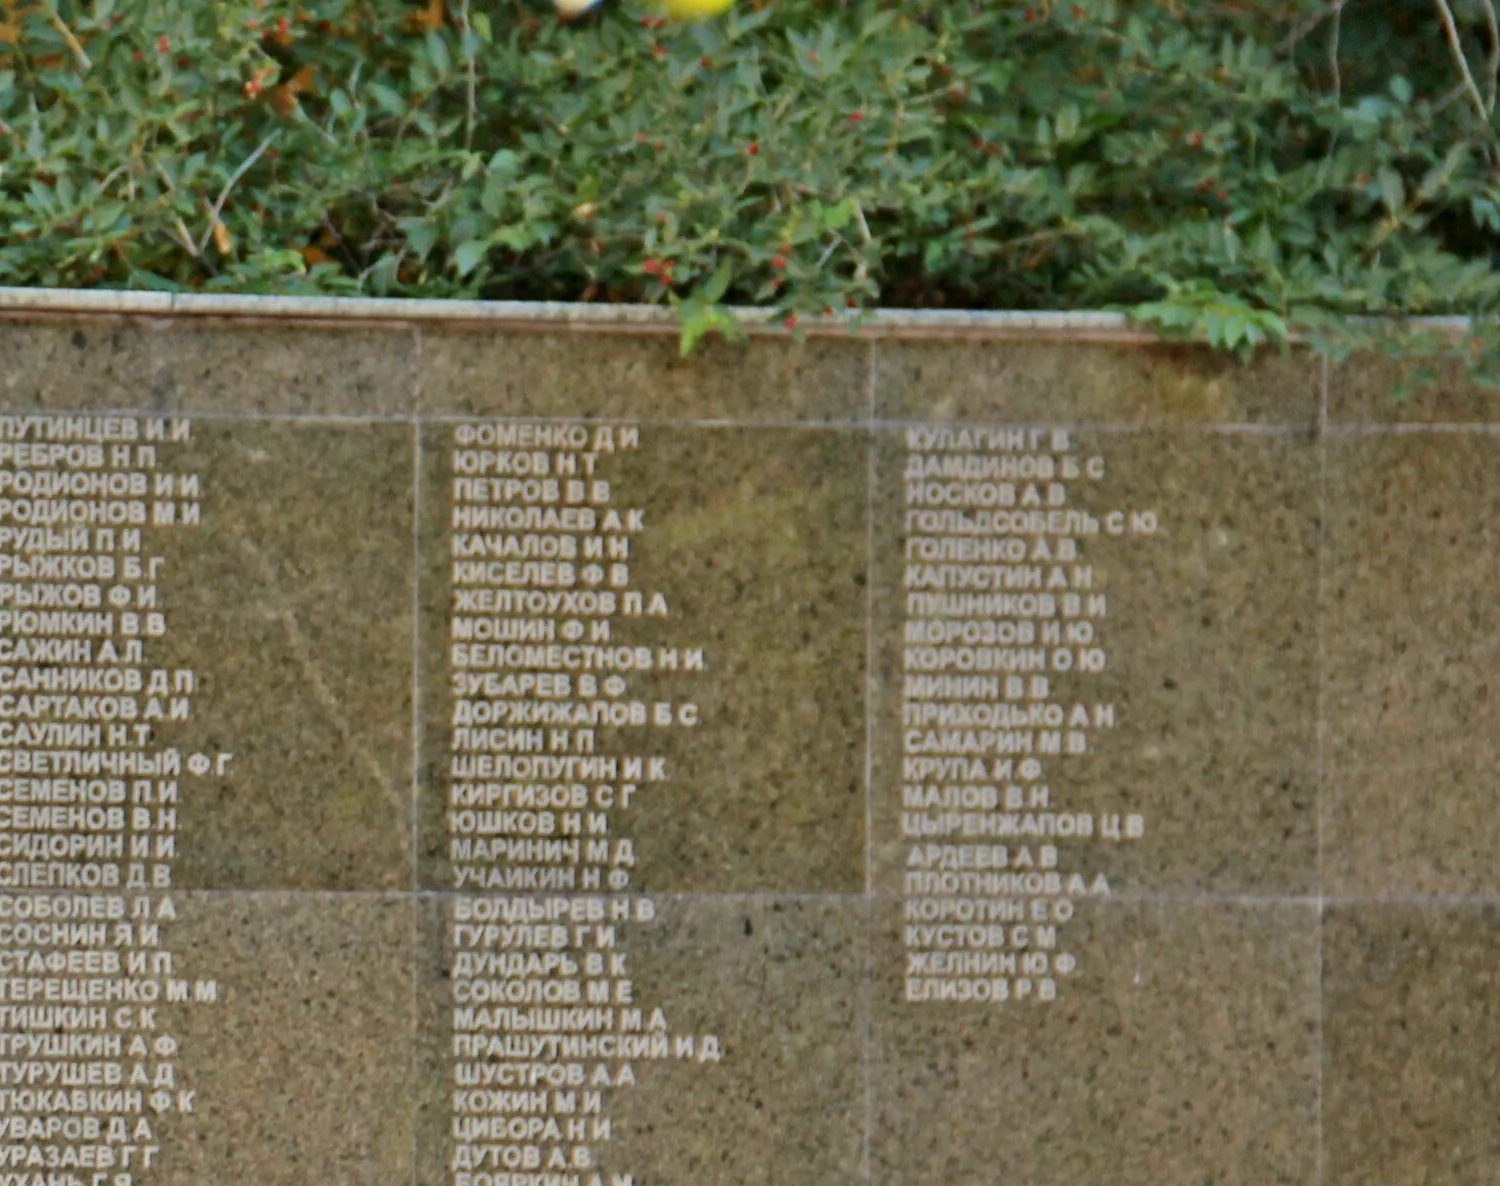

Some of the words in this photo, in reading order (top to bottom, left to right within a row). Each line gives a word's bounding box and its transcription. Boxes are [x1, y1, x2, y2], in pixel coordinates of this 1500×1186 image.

[454, 423, 587, 447] ФОМЕНКО
[453, 450, 548, 474] ЮРКОВ
[453, 478, 558, 501] ПЕТРОВ
[908, 483, 1015, 505] НОСКОВ
[452, 506, 595, 530] НИКОЛАЕВ
[453, 535, 576, 558] КАЧАЛОВ
[905, 565, 1042, 588] КАПУСТИН
[453, 590, 615, 614] ЖЕЛТОУХОВ
[452, 618, 554, 640] МОШИН
[452, 644, 651, 669] БЕЛОМЕСТНОВ
[903, 648, 1045, 670] КОРОВКИН
[452, 673, 571, 696] ЗУБАРЕВ
[904, 676, 998, 698] МИНИН
[903, 703, 1063, 728] ПРИХОДЬКО
[452, 729, 542, 750] ЛИСИН
[904, 731, 1032, 753] САМАРИН
[452, 756, 616, 778] ШЕЛОПУГИН
[903, 758, 985, 780] КРУПА
[452, 784, 587, 807] КИРГИЗОВ
[451, 812, 554, 833] ЮШКОВ
[908, 845, 1008, 869] АРДЕЕВ
[454, 897, 603, 922] БОЛДЫРЕВ
[905, 899, 1023, 921] КОРОТИН
[454, 925, 568, 947] ГУРУЛЕВ
[905, 926, 1004, 948] КУСТОВ
[452, 952, 577, 979] ДУНДАРЬ
[906, 952, 1015, 974] ЖЕЛНИН
[453, 981, 580, 1003] СОКОЛОВ
[453, 1008, 613, 1030] МАЛЫШКИН
[455, 1063, 584, 1085] ШУСТРОВ
[453, 1091, 547, 1112] КОЖИН
[452, 1146, 540, 1170] ДУТОВ
